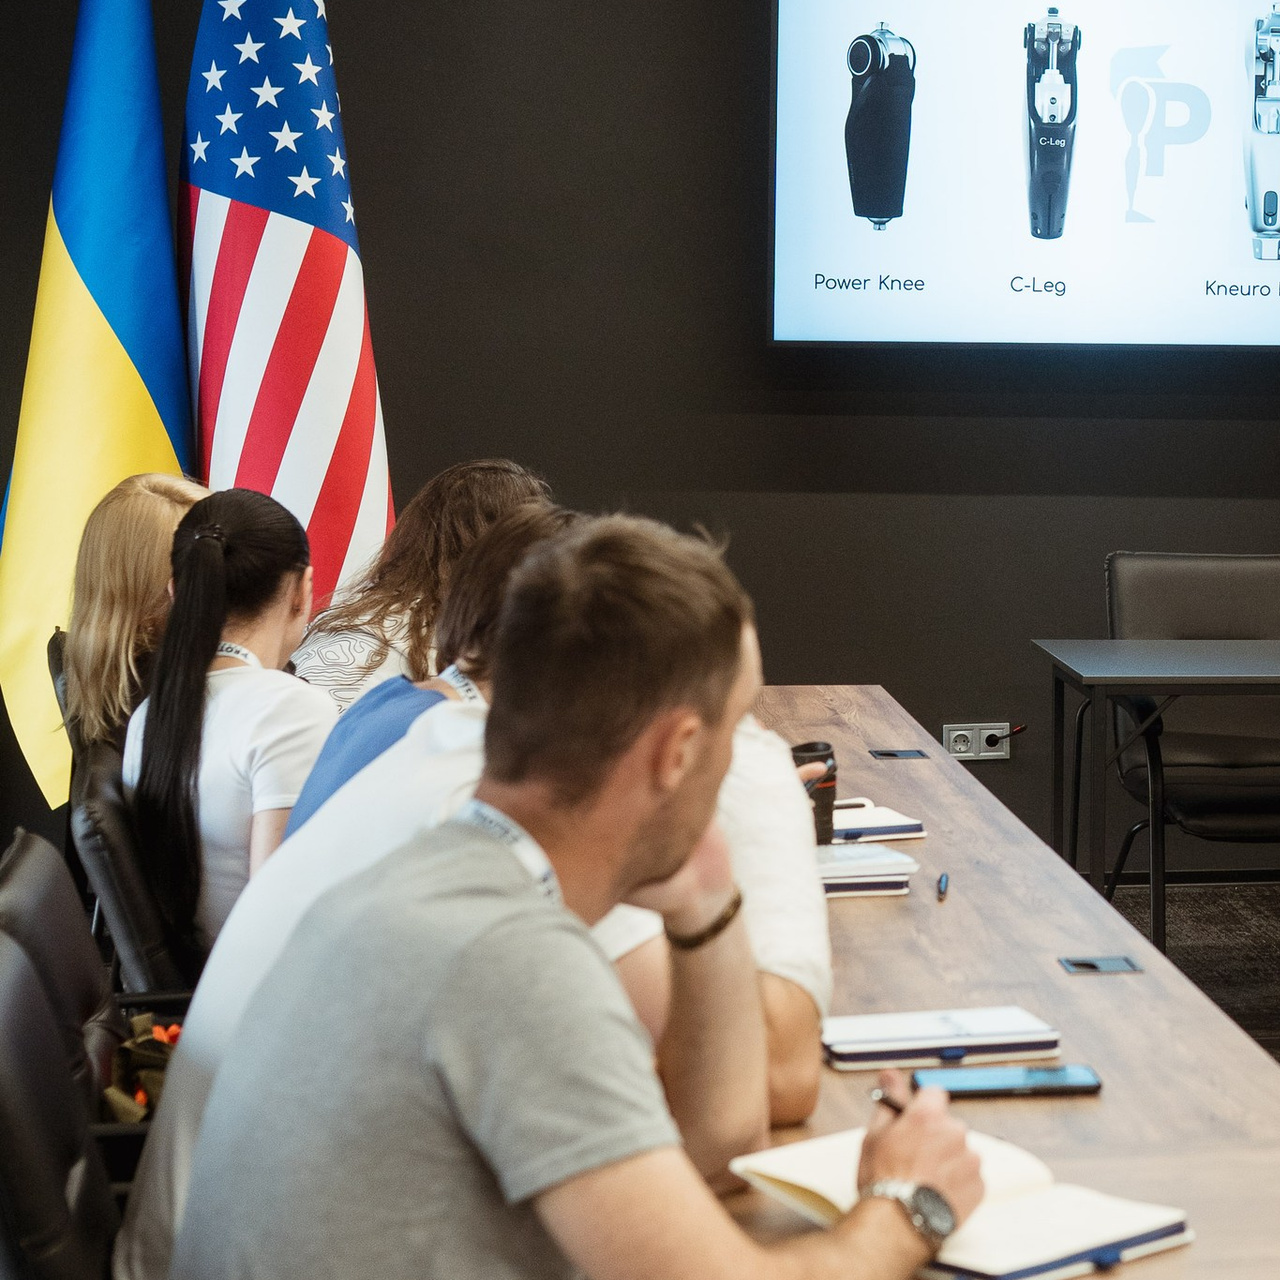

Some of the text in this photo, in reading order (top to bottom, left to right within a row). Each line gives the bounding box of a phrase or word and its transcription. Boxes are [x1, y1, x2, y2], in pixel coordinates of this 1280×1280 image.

[1039, 137, 1066, 148] C-Leg
[814, 273, 925, 291] Power Knee
[1010, 276, 1066, 297] C-Leg
[1205, 280, 1271, 297] Kneuro
